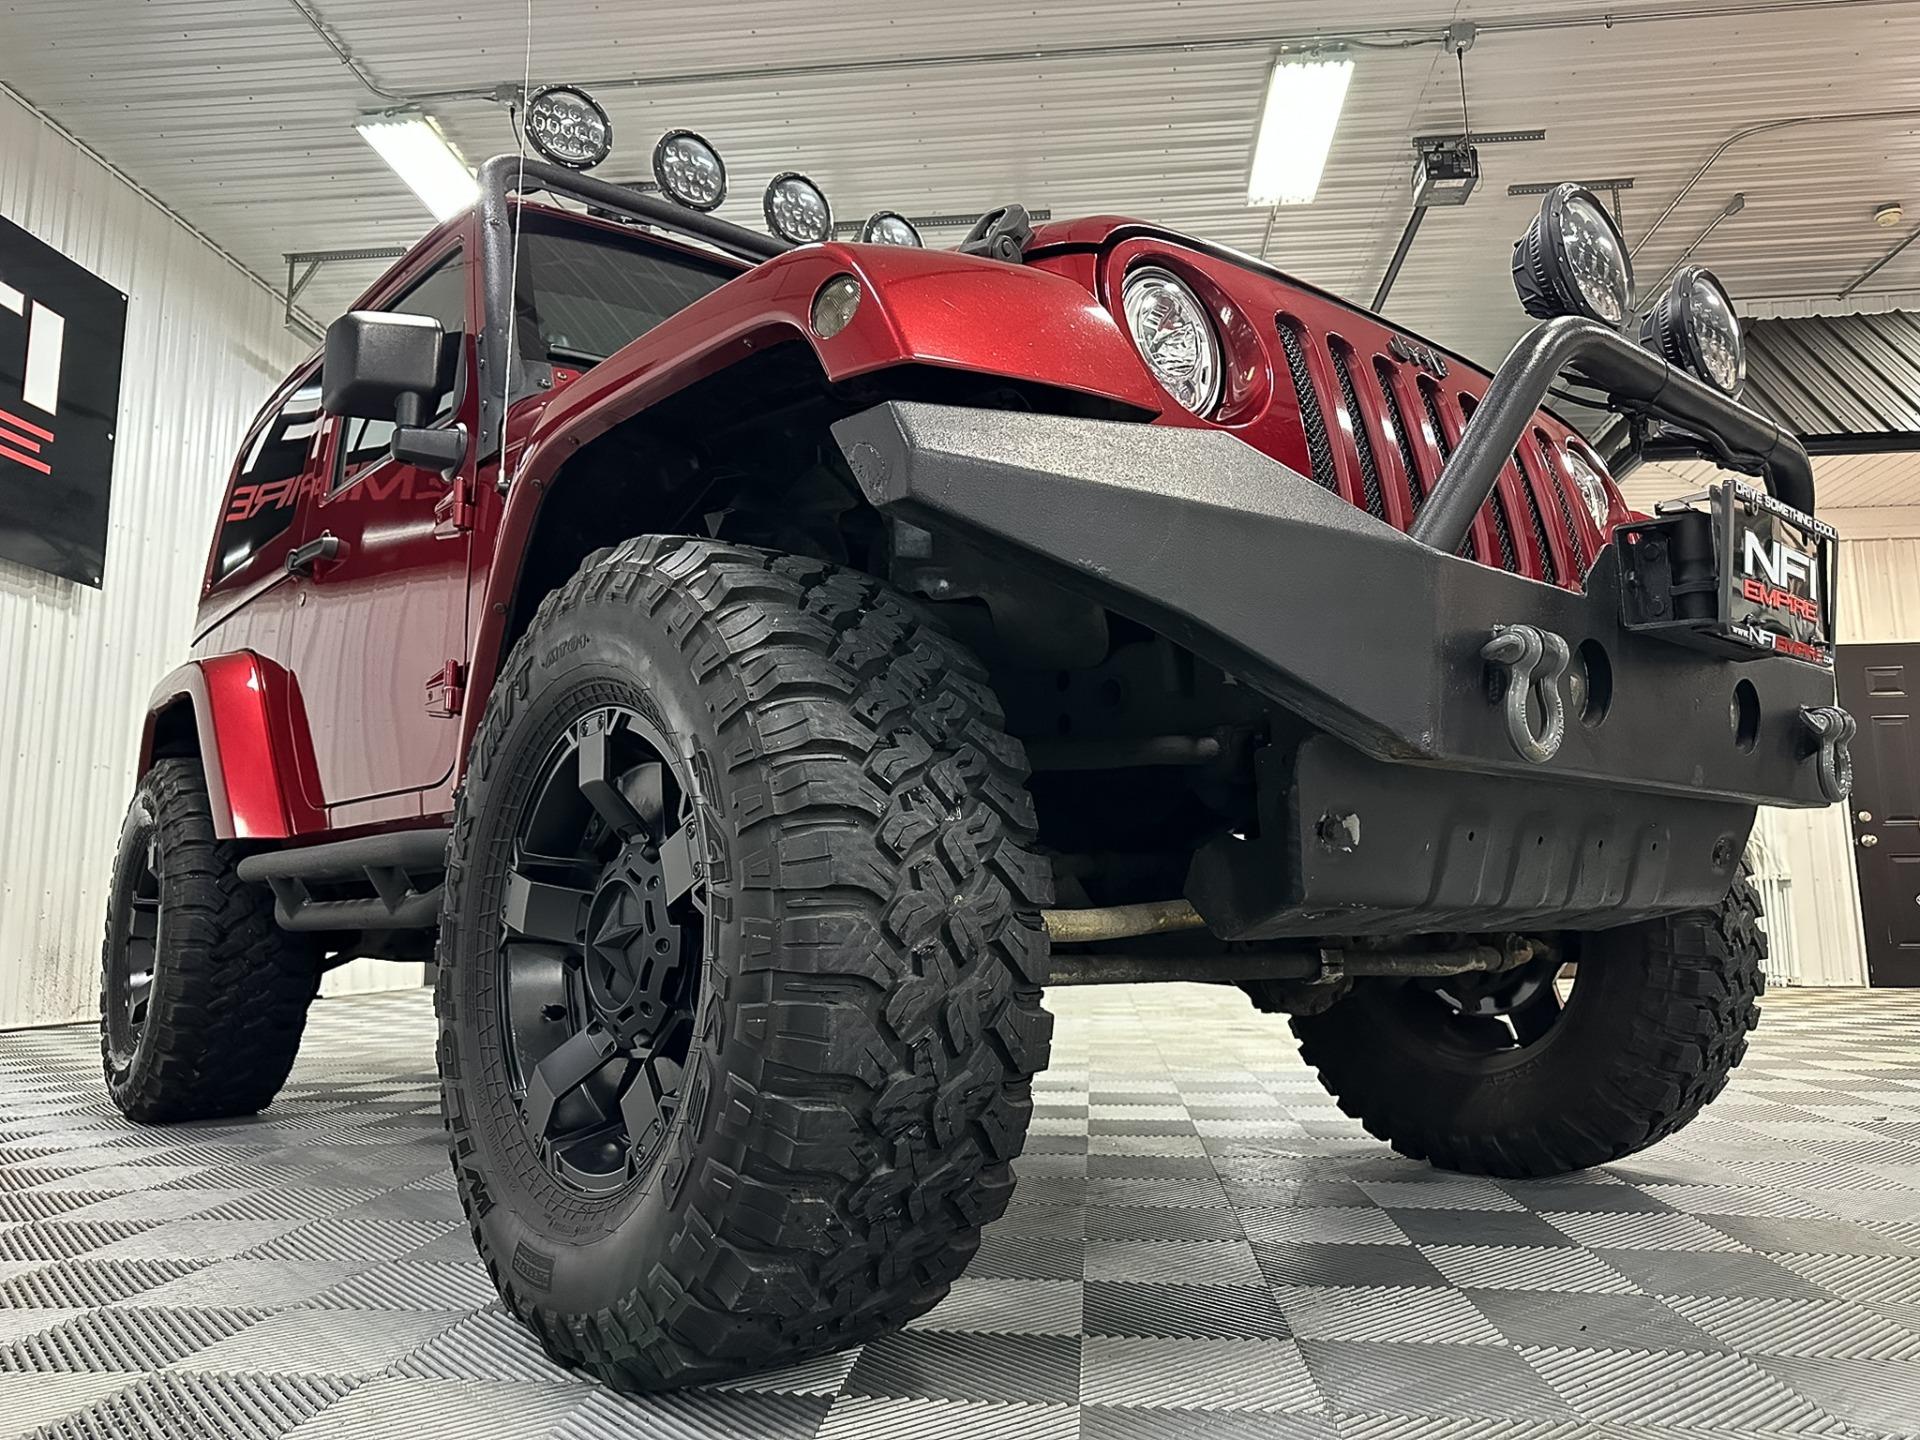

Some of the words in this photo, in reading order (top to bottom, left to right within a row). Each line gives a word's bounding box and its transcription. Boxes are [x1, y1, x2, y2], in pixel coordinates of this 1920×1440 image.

[1735, 481, 1763, 505] DRIVE
[1764, 494, 1812, 526] SOMETHING
[1743, 526, 1818, 602] NFI
[1743, 578, 1818, 623] EMPIRE
[436, 793, 496, 1218] WILDPEAK
[661, 733, 734, 1210] FALKEN
